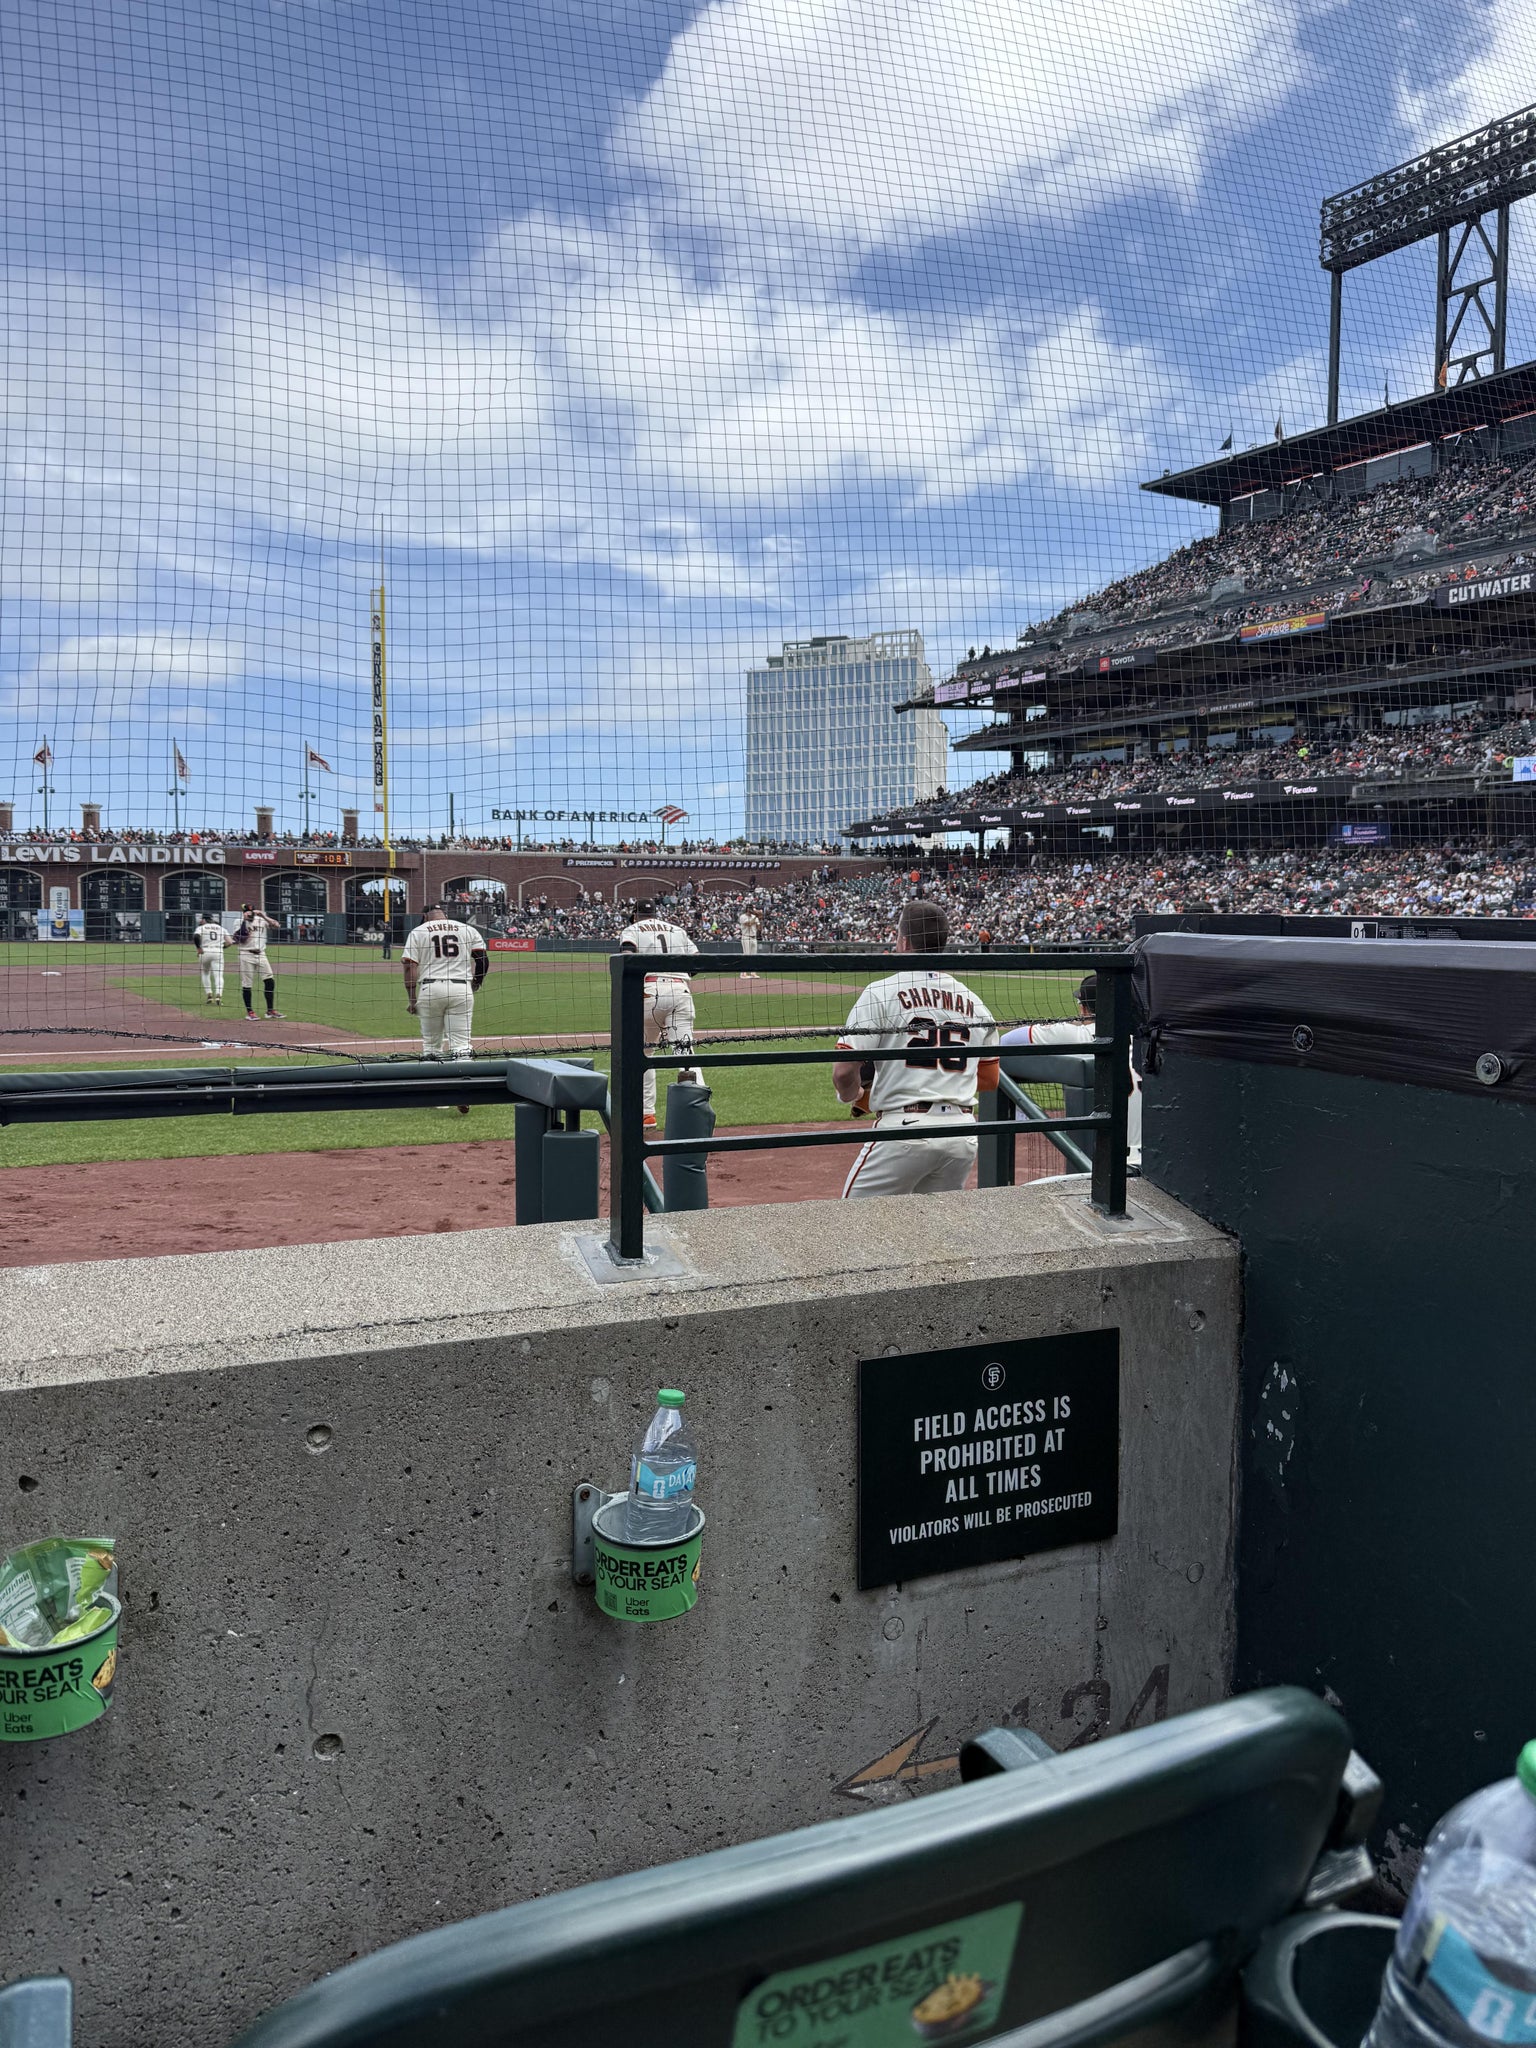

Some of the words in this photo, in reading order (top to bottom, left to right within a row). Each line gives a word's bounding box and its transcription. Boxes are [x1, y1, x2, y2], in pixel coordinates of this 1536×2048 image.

[1448, 573, 1531, 604] CUTWATER
[1256, 622, 1290, 638] Surfside
[1111, 656, 1135, 666] TOYOTA
[492, 809, 538, 820] BANK
[544, 810, 565, 821] OF
[570, 811, 649, 823] AMERICA
[91, 847, 226, 864] LANDING
[210, 931, 217, 940] 0
[363, 933, 384, 942] 309
[427, 924, 459, 932] DEVERS
[431, 935, 459, 958] 16
[495, 941, 529, 949] ORACLE
[897, 987, 974, 1018] CHAPMAN
[905, 1017, 970, 1074] 26
[914, 1411, 966, 1442] FIELD
[974, 1399, 1046, 1433] ACCESS
[1053, 1395, 1071, 1420] IS
[920, 1433, 1036, 1475] PROHIBITED
[1044, 1428, 1065, 1453] AT
[945, 1475, 979, 1503] ALL
[986, 1464, 1041, 1495] TIMES
[889, 1516, 960, 1545] VIOLATORS
[963, 1510, 992, 1531] WILL
[996, 1506, 1012, 1524] BE
[1015, 1491, 1092, 1520] PROSECUTED
[644, 1554, 687, 1577] EATS
[607, 1571, 647, 1591] YOUR
[651, 1569, 687, 1590] SEAT
[625, 1597, 650, 1607] Uber
[626, 1606, 650, 1616] Eats
[23, 1658, 83, 1688] EATS
[34, 1675, 83, 1702] SEAT
[4, 1712, 32, 1723] Uber
[5, 1723, 33, 1733] Eats
[757, 1963, 879, 2018] ORDER
[881, 1936, 960, 1982] EATS
[757, 2013, 797, 2044] TO
[803, 1983, 880, 2029] YOUR
